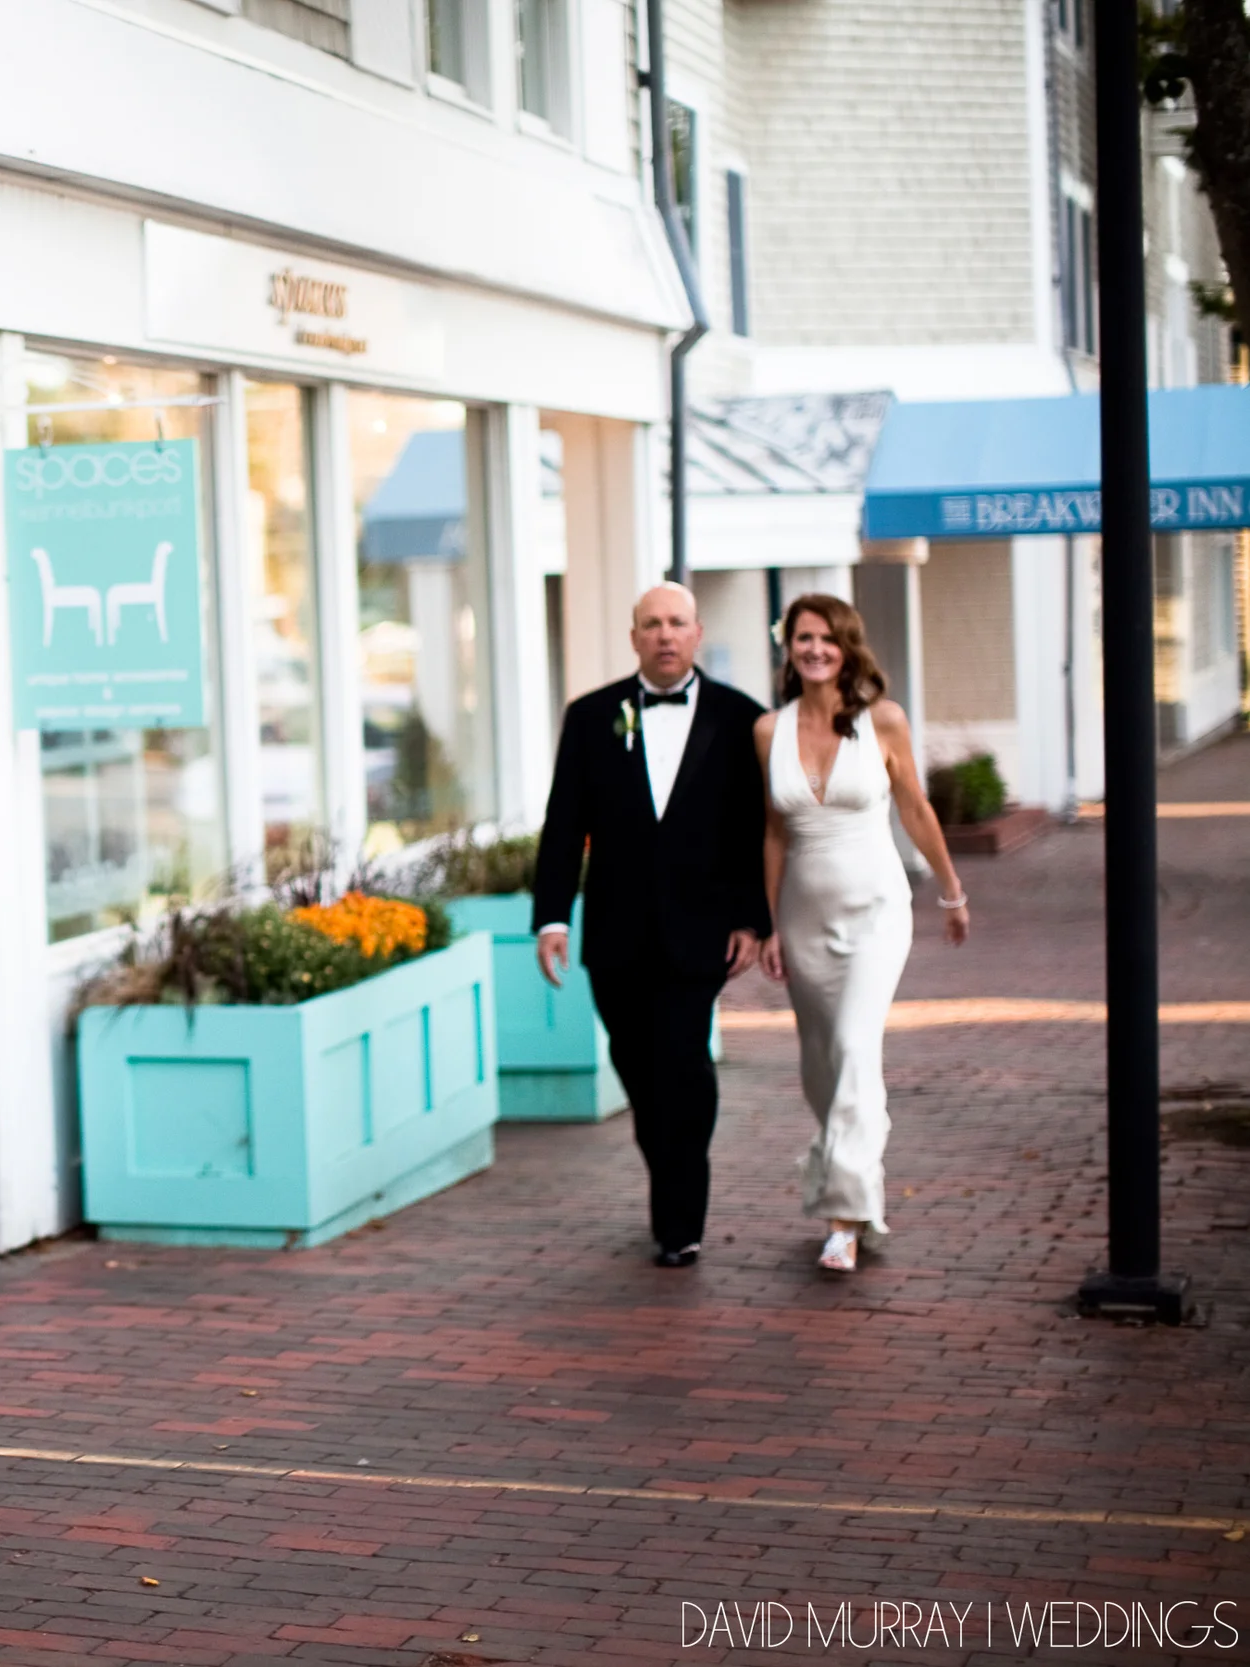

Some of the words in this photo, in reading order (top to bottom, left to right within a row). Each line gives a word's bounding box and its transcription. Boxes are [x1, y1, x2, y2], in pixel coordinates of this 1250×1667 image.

[15, 449, 182, 499] spaces
[975, 488, 1180, 531] BREAKWR
[1186, 486, 1244, 520] INN
